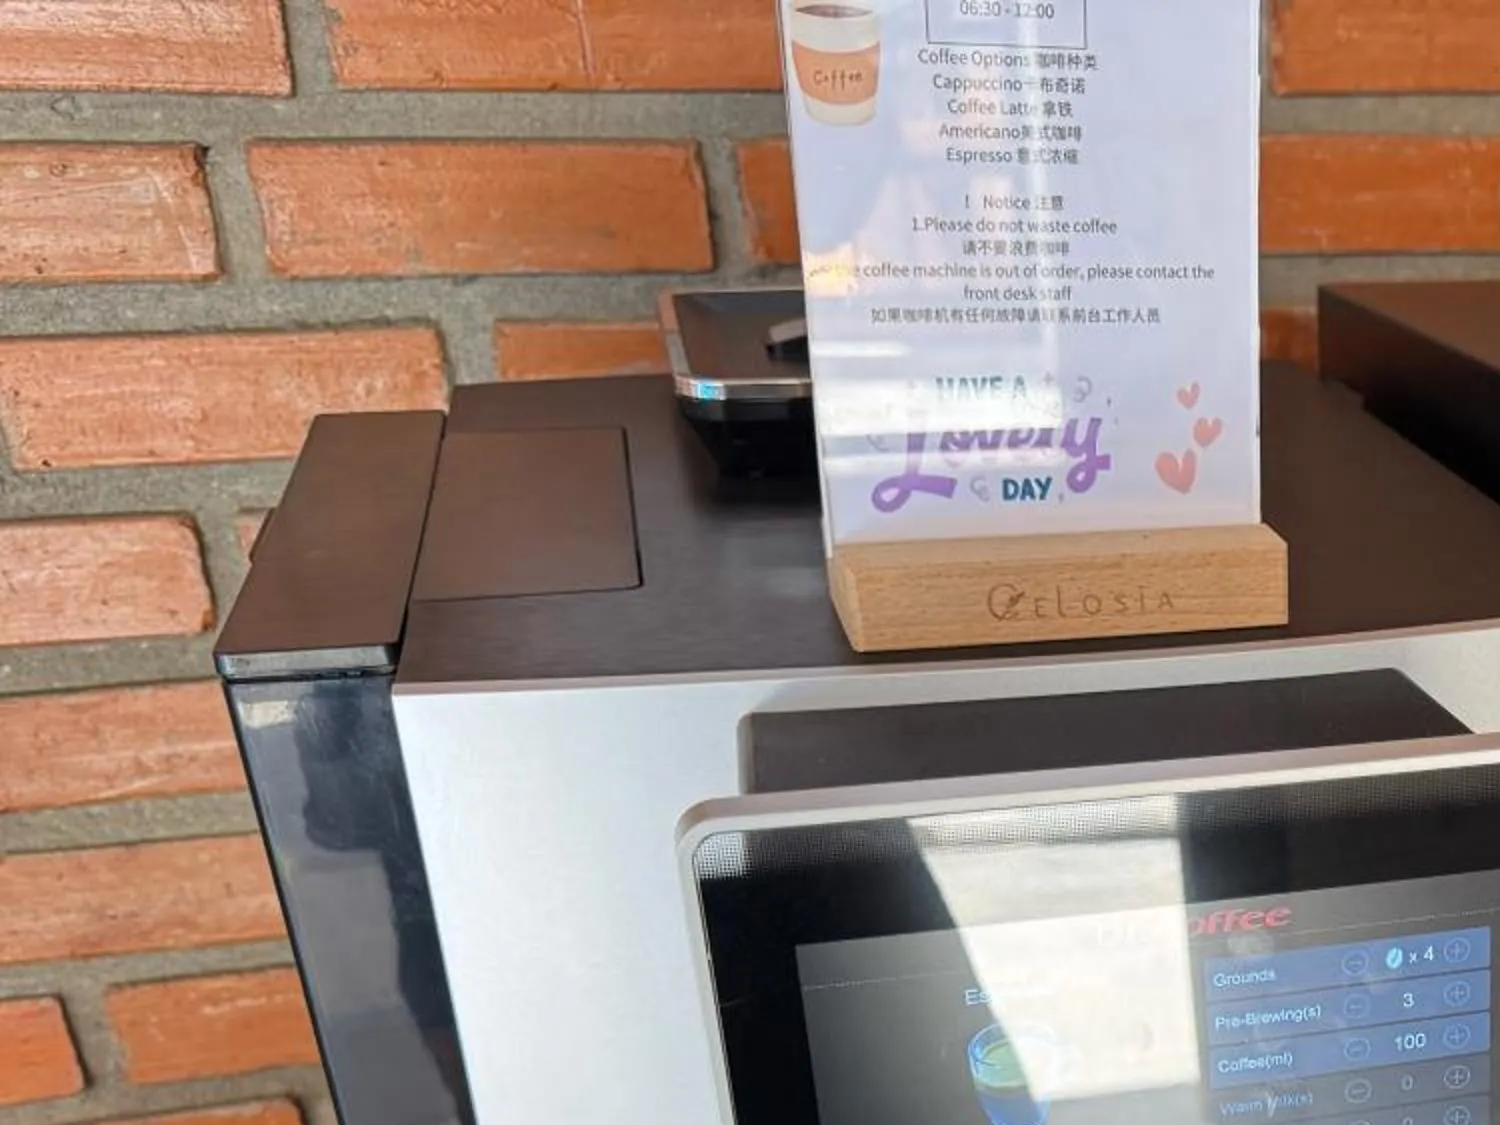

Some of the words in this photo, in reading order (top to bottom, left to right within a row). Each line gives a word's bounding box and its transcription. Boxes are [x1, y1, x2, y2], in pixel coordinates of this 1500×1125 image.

[917, 48, 968, 64] Coffee
[932, 73, 1023, 93] Cappuccino
[947, 99, 996, 115] Coffee
[939, 123, 1020, 140] Americano
[946, 147, 1013, 165] Espresso
[983, 195, 1031, 210] Notice
[976, 217, 995, 233] do
[999, 219, 1024, 234] not
[1026, 219, 1070, 234] waste
[1073, 218, 1118, 235] coffee
[862, 261, 910, 278] coffee
[913, 262, 977, 279] machine
[980, 263, 993, 279] is
[995, 264, 1019, 279] out
[1023, 263, 1038, 279] of
[1087, 264, 1134, 283] please
[1136, 265, 1188, 280] contact
[1191, 264, 1215, 280] the
[963, 283, 1000, 300] front
[1003, 284, 1037, 301] desk
[935, 375, 1004, 401] HAVE
[1012, 373, 1028, 401] A
[1002, 476, 1053, 501] DAY
[1213, 967, 1277, 988] Grounds
[1423, 945, 1435, 961] 4
[1215, 1003, 1322, 1030] Pre-Brewing(s)
[1402, 993, 1415, 1008] 3
[1217, 1051, 1294, 1074] Coffee(ml)
[1394, 1031, 1427, 1051] 100
[1401, 1075, 1414, 1091] 0
